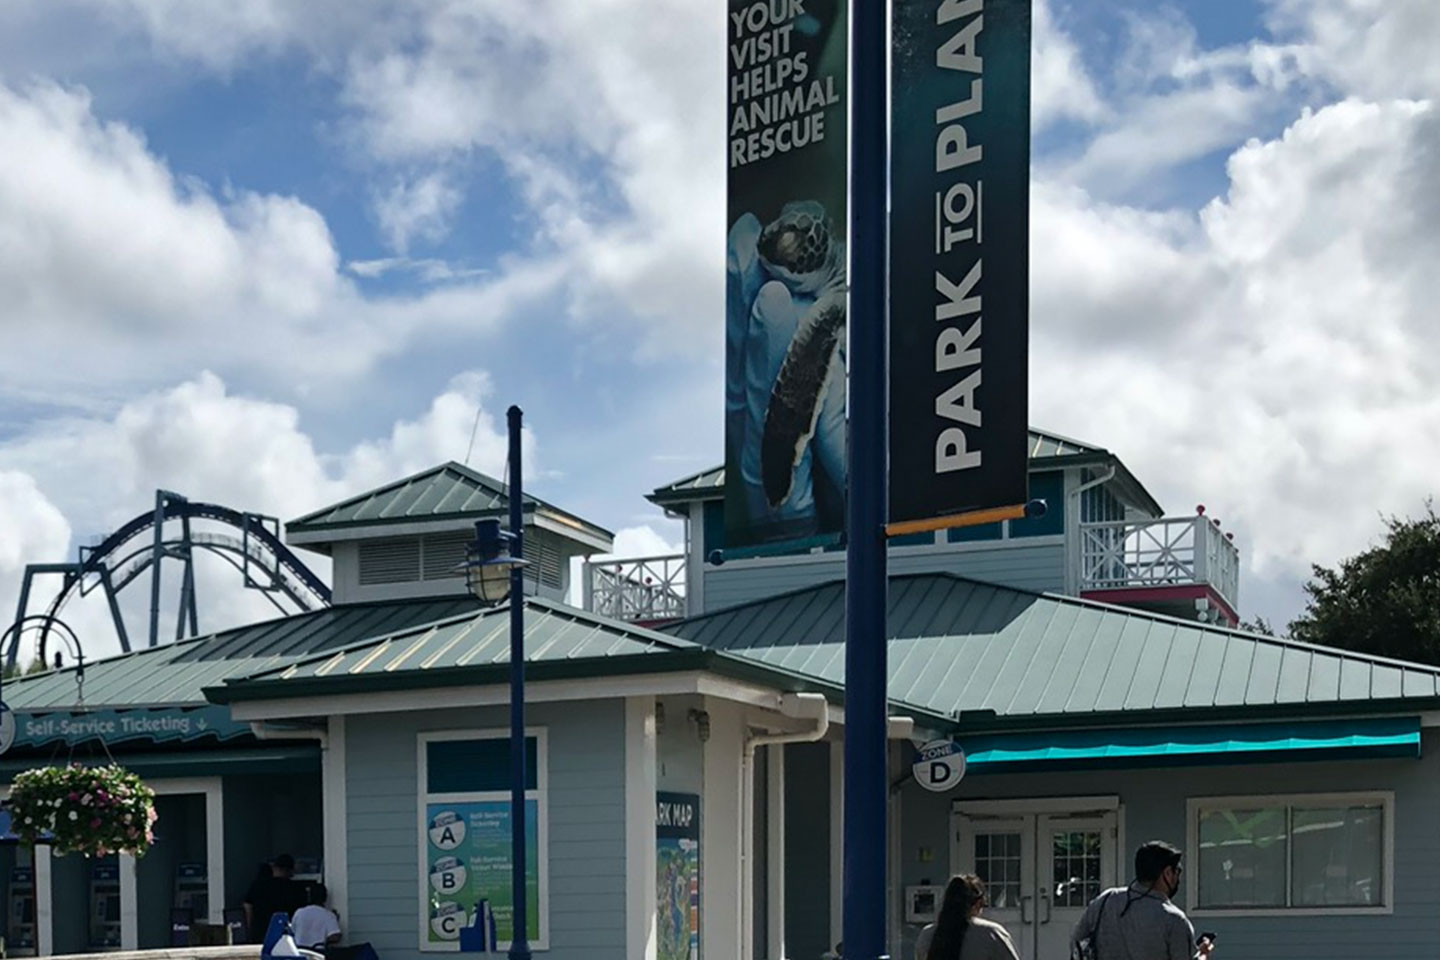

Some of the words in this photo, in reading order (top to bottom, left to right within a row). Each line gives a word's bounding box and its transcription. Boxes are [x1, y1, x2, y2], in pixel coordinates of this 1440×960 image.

[731, 0, 805, 38] YOUR
[730, 23, 794, 70] VISIT
[731, 51, 809, 104] HELPS
[730, 75, 840, 136] ANIMAL
[731, 111, 824, 168] RESCUE
[943, 182, 975, 252] TO
[935, 258, 982, 474] PARK
[25, 718, 115, 737] Self-Service
[120, 716, 190, 733] Ticketing
[921, 745, 953, 761] ZONE
[930, 761, 951, 784] D
[656, 802, 671, 826] RK
[672, 803, 693, 827] MAP
[440, 826, 457, 844] A
[442, 872, 456, 889] B
[441, 916, 456, 933] C
